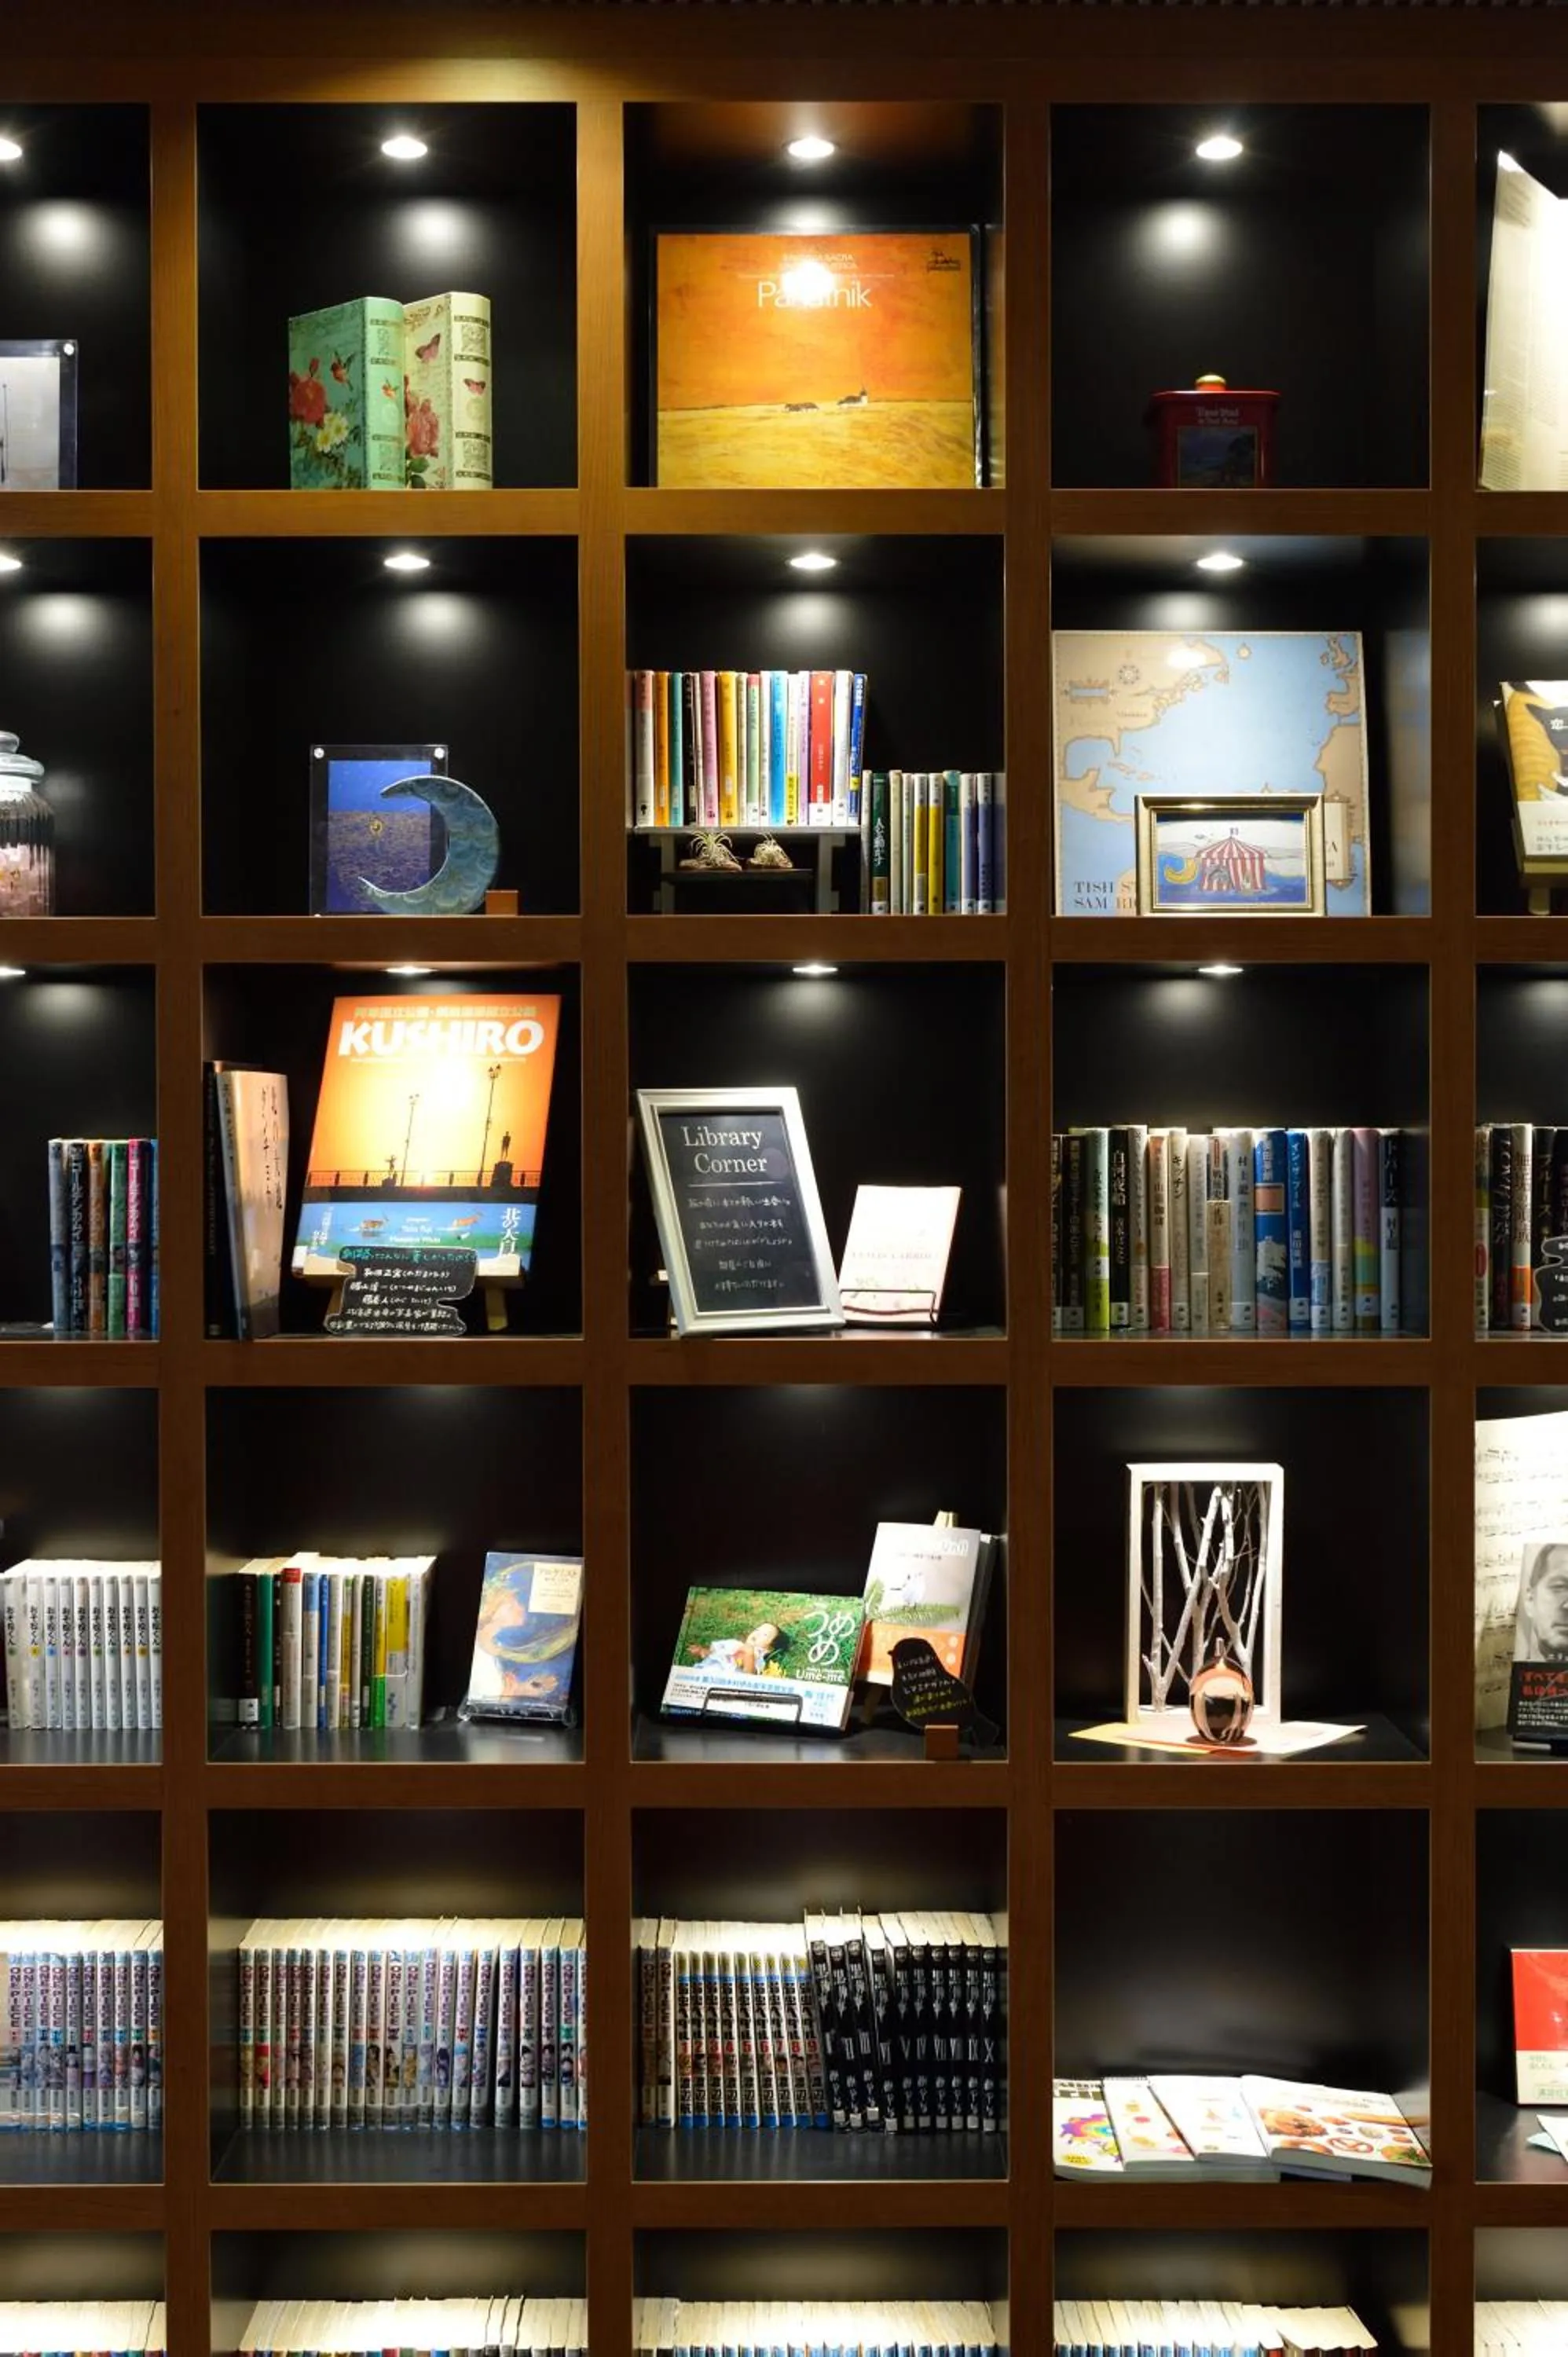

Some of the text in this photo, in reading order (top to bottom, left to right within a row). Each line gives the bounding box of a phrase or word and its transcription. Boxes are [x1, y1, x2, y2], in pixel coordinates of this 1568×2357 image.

[338, 1019, 544, 1057] KUSHIRO
[681, 1126, 764, 1150] Library
[694, 1153, 768, 1174] Corner
[681, 2042, 688, 2053] 1
[694, 2042, 702, 2053] 2
[710, 2042, 719, 2053] 3
[726, 2042, 735, 2053] 4
[743, 2042, 751, 2053] 5
[760, 2042, 769, 2053] 6
[776, 2042, 784, 2053] 7
[792, 2042, 801, 2053] 8
[808, 2042, 817, 2053] 9
